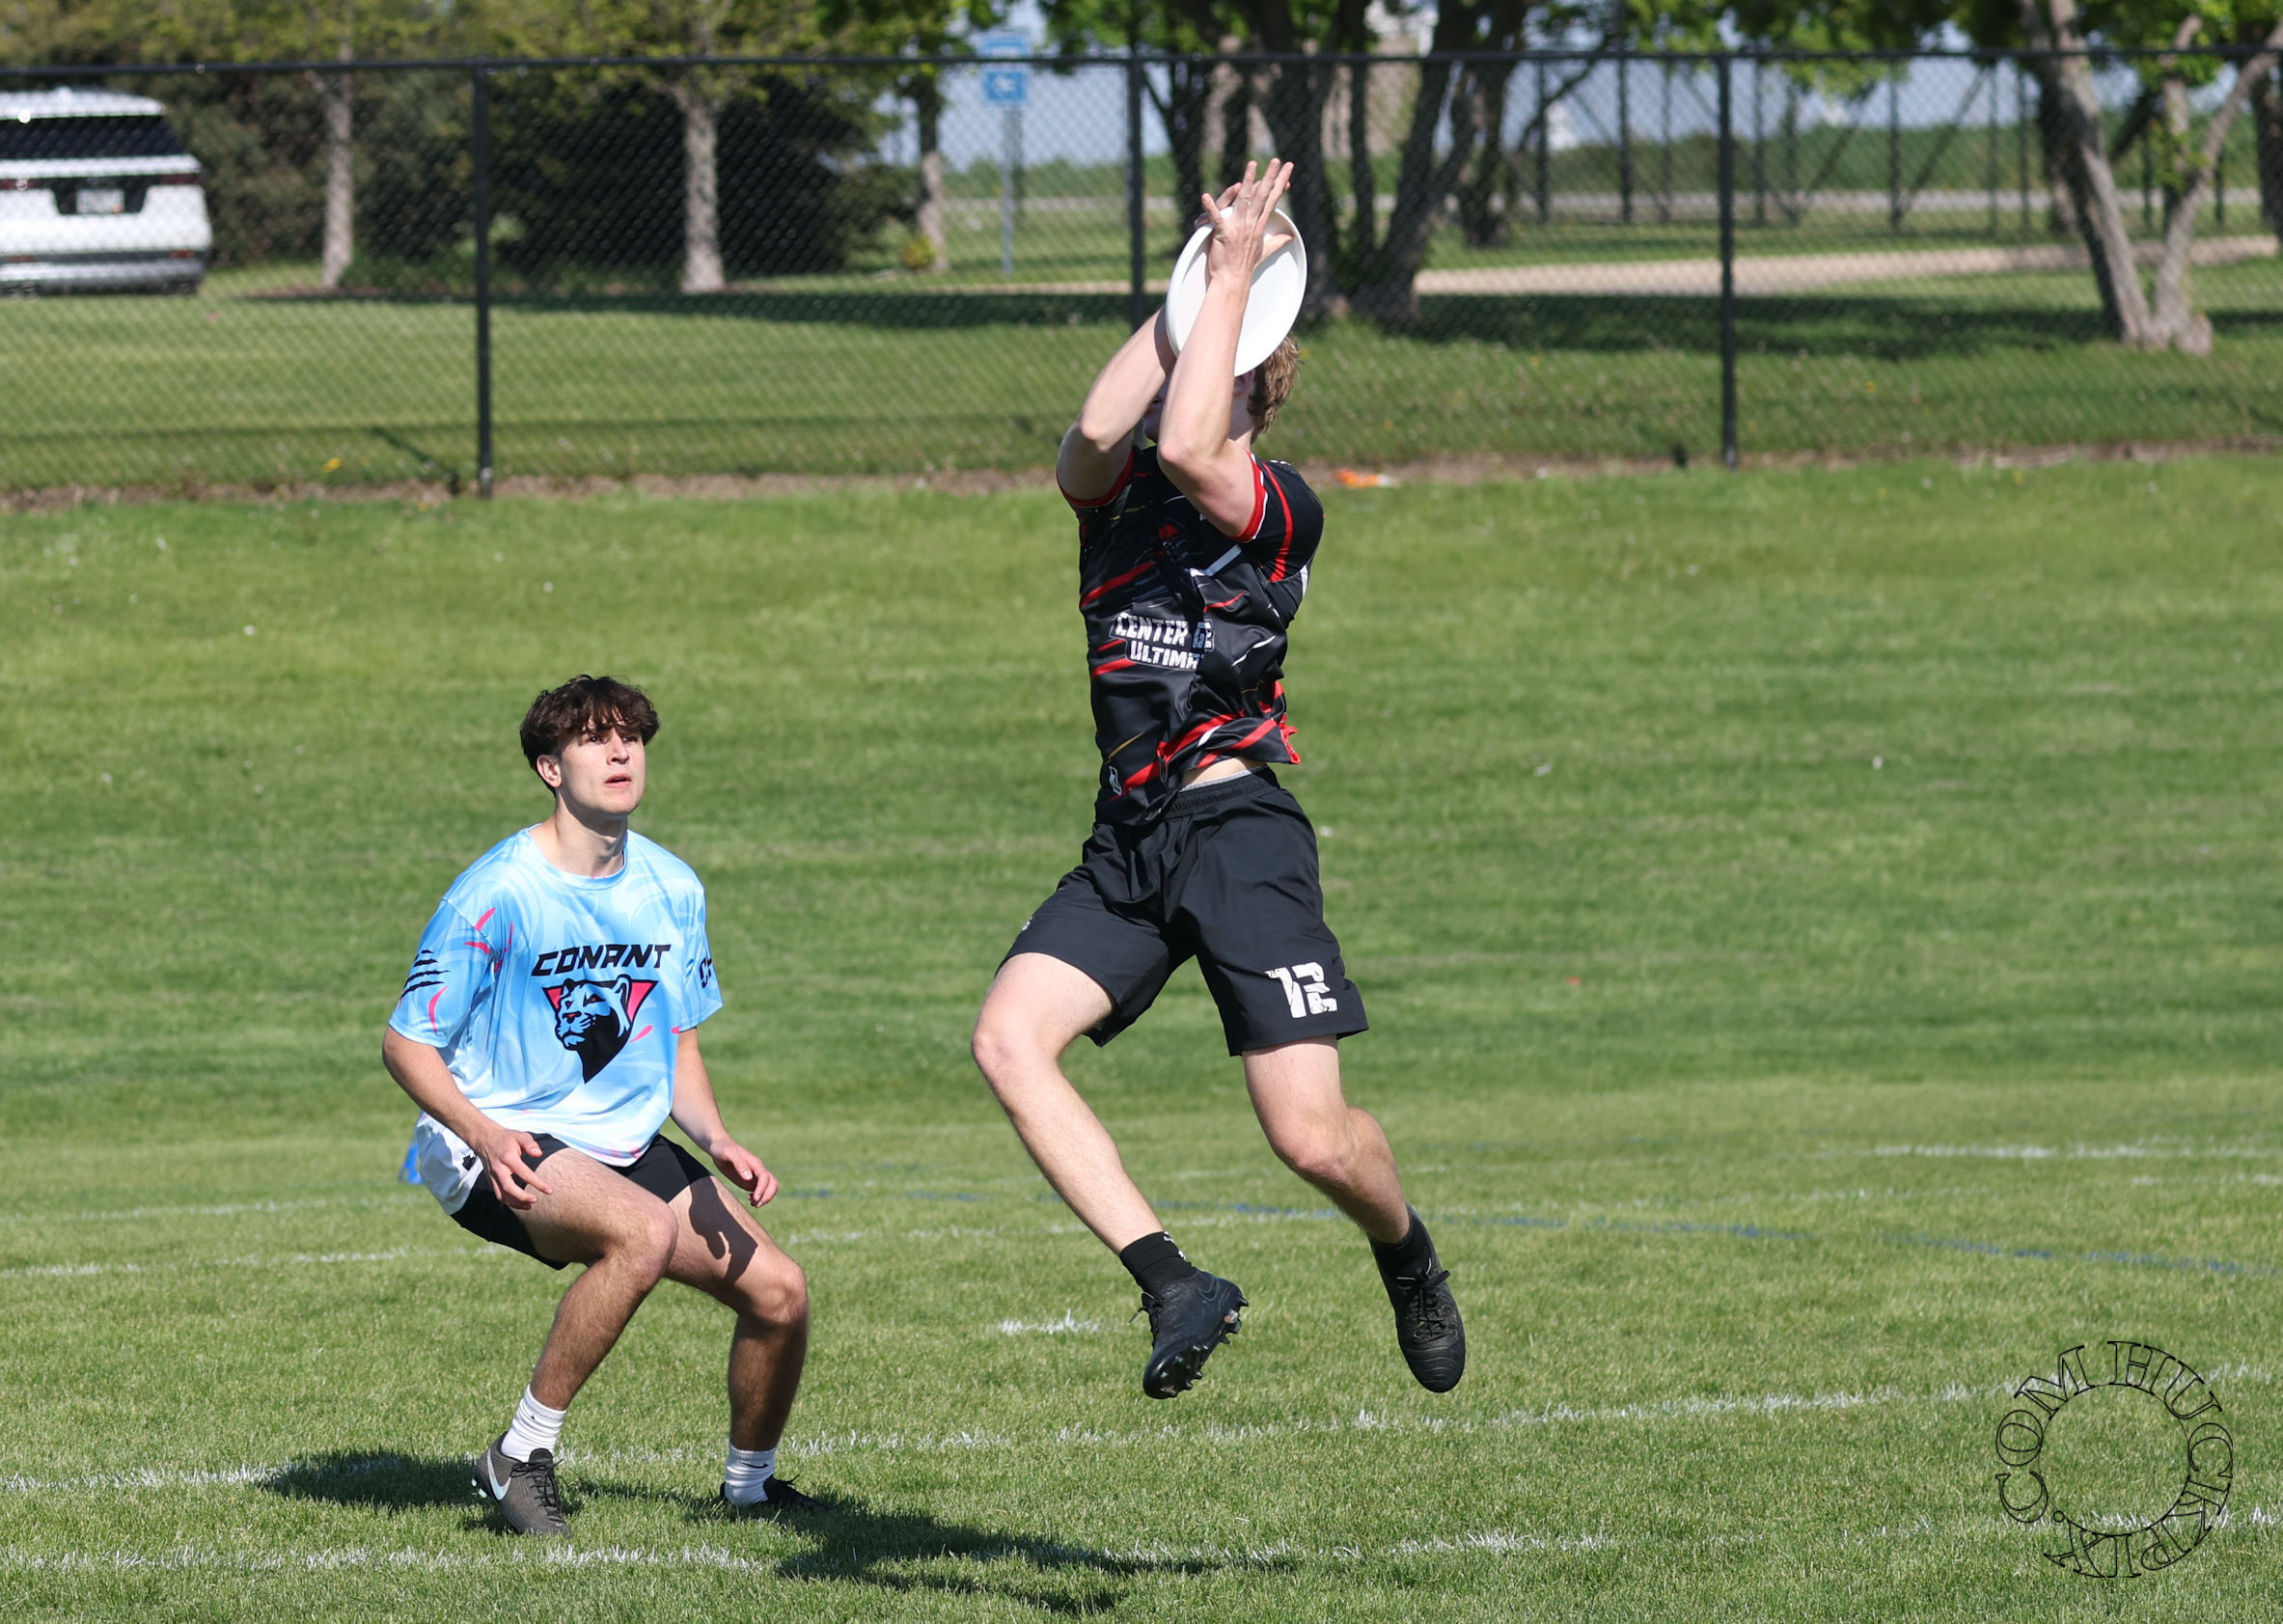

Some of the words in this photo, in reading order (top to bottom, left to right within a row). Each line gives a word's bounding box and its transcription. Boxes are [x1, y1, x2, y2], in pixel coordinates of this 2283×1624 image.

[1115, 612, 1188, 647] CENTER
[1130, 640, 1204, 670] ULTIMA
[531, 944, 672, 977] CONANT
[1264, 961, 1338, 1018] 12
